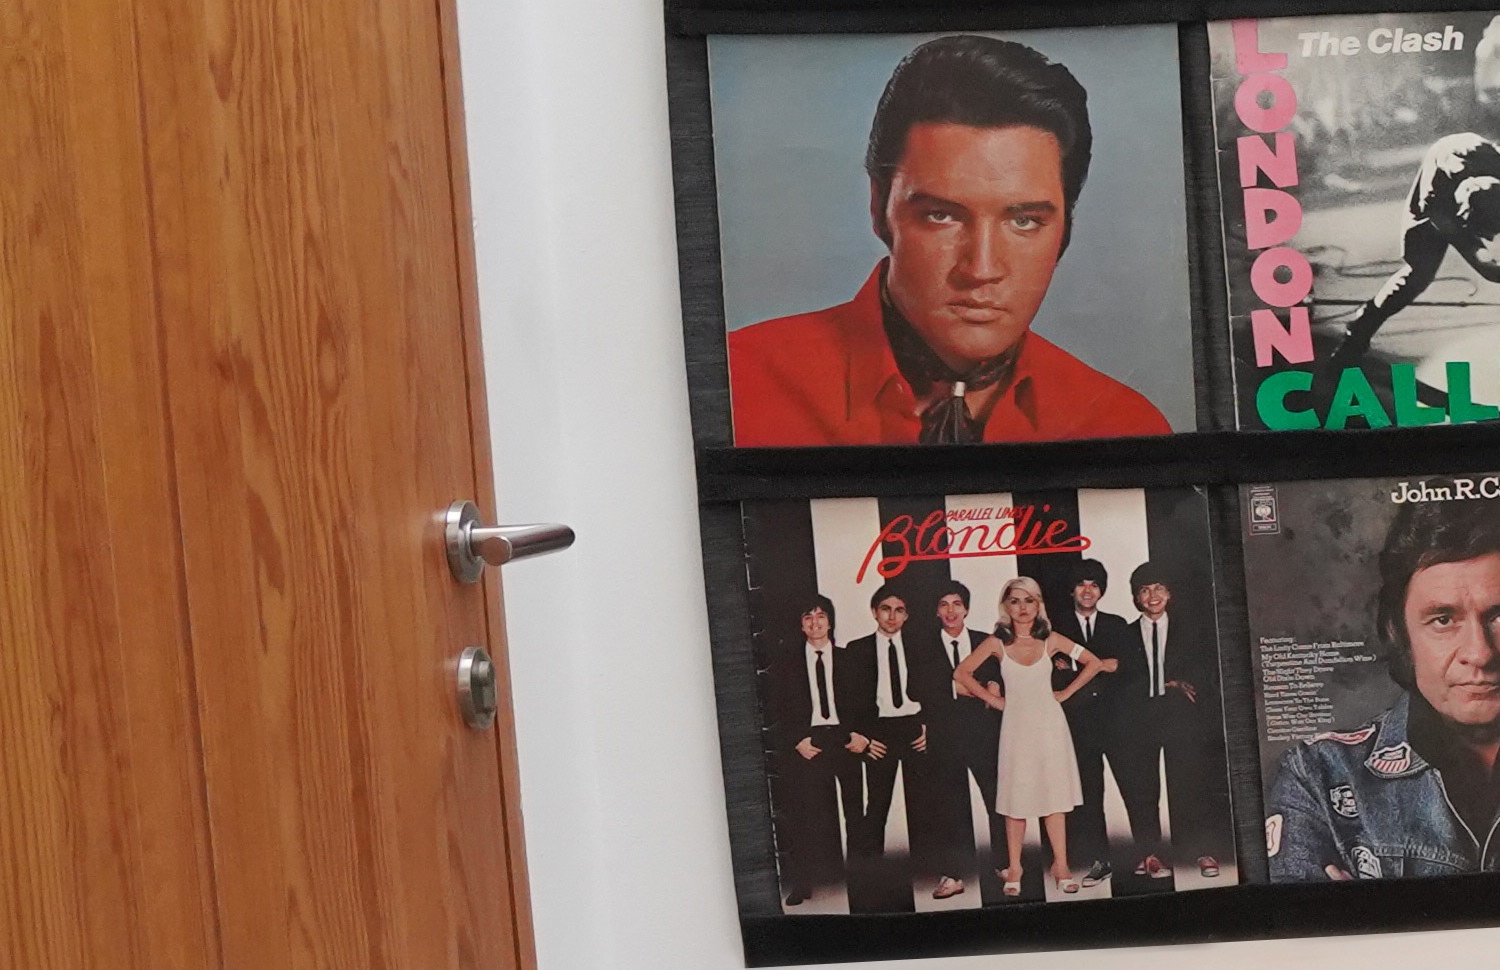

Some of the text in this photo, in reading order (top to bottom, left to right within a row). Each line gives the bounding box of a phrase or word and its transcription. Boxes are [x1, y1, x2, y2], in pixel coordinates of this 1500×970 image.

[1298, 25, 1464, 58] The Clash
[1231, 18, 1315, 368] LONDON
[1391, 481, 1453, 504] John
[945, 507, 992, 522] PARALLEL
[856, 504, 1092, 584] Blondie
